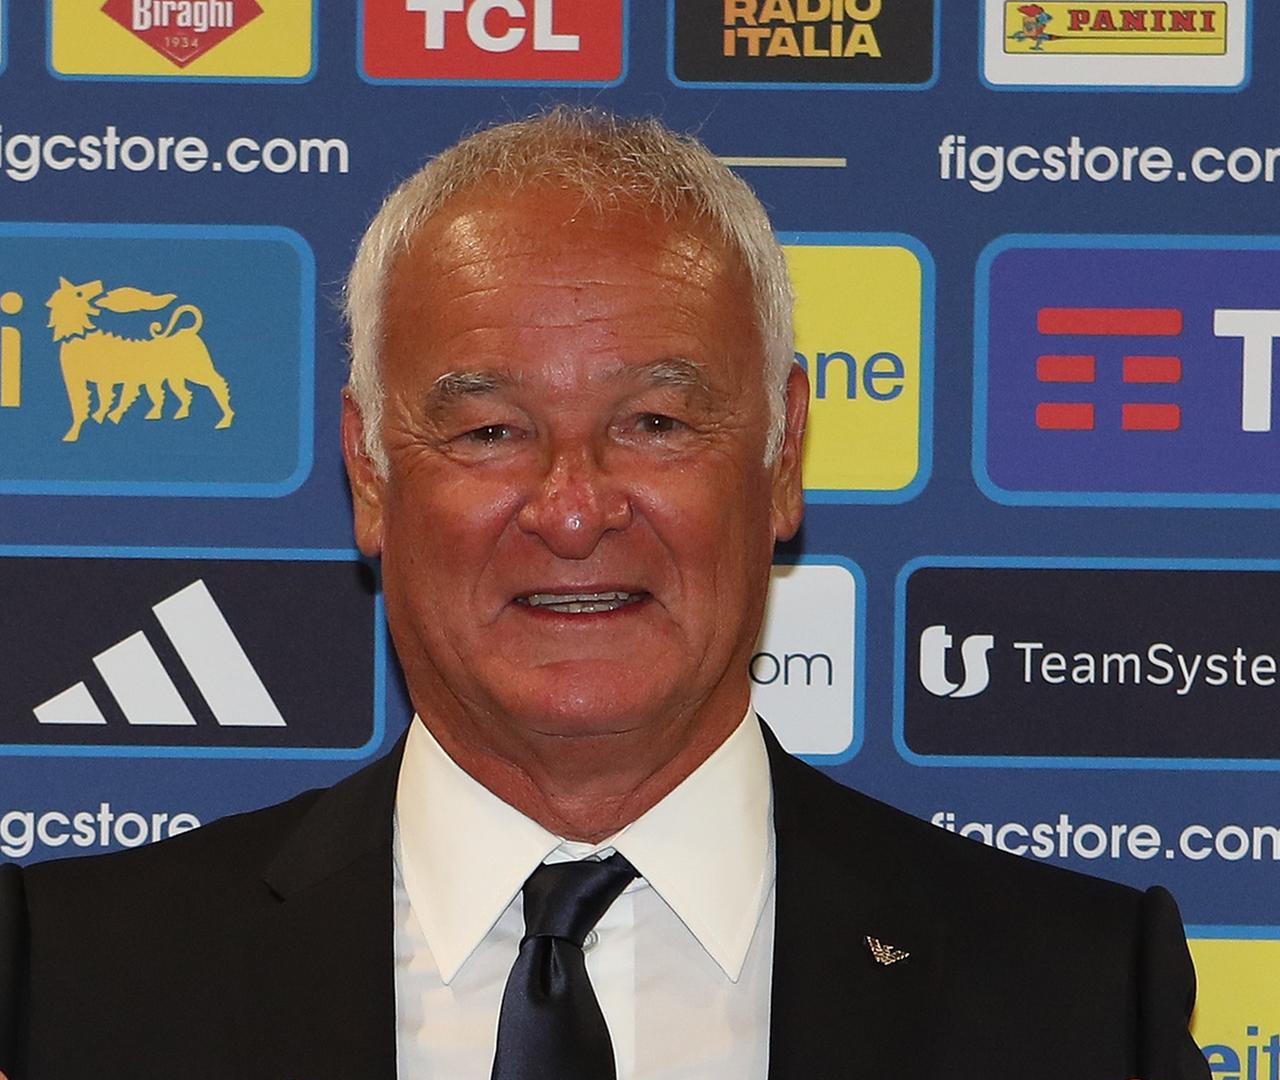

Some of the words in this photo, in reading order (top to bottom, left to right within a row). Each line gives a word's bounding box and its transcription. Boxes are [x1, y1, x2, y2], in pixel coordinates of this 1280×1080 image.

[132, 0, 234, 32] Biraghi
[407, 0, 580, 53] TCL
[723, 0, 881, 25] RADIO
[1067, 9, 1216, 32] PANINI
[164, 36, 199, 48] 1934
[723, 24, 882, 57] ITALIA
